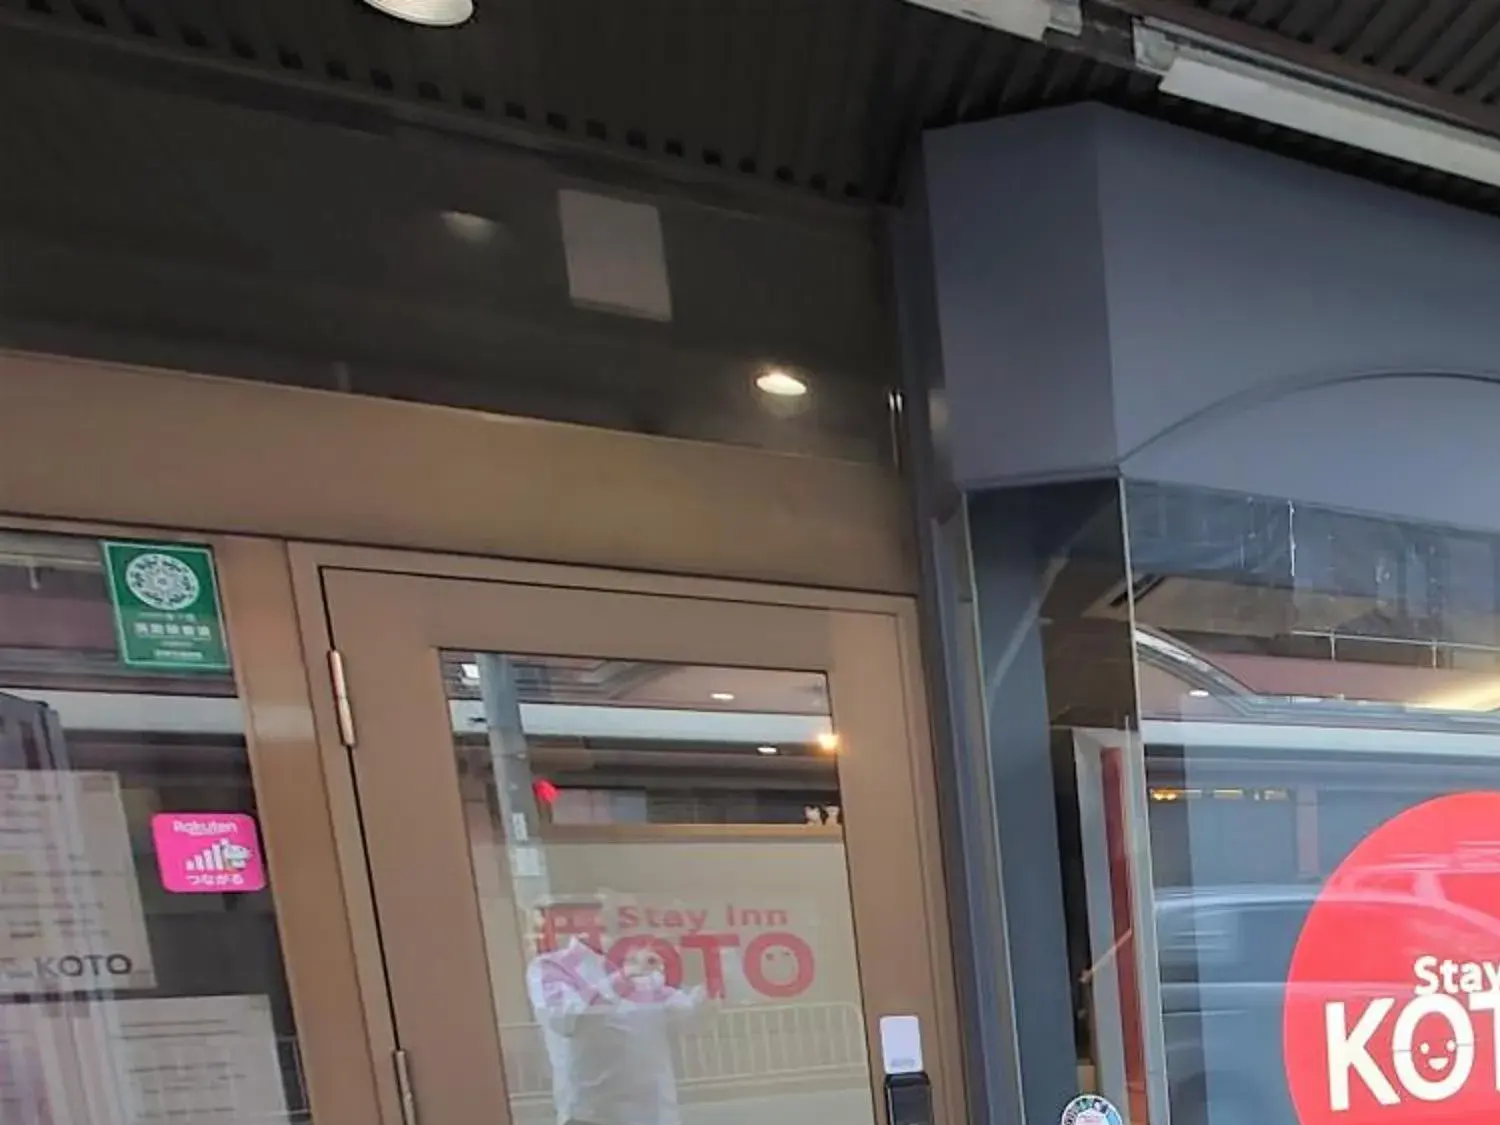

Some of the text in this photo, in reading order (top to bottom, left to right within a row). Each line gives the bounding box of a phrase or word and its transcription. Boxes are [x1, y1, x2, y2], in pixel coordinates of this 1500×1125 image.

[173, 820, 238, 835] Rakuten
[186, 874, 244, 885] つながる
[617, 903, 788, 931] Stay Inn
[34, 954, 132, 978] KOTO
